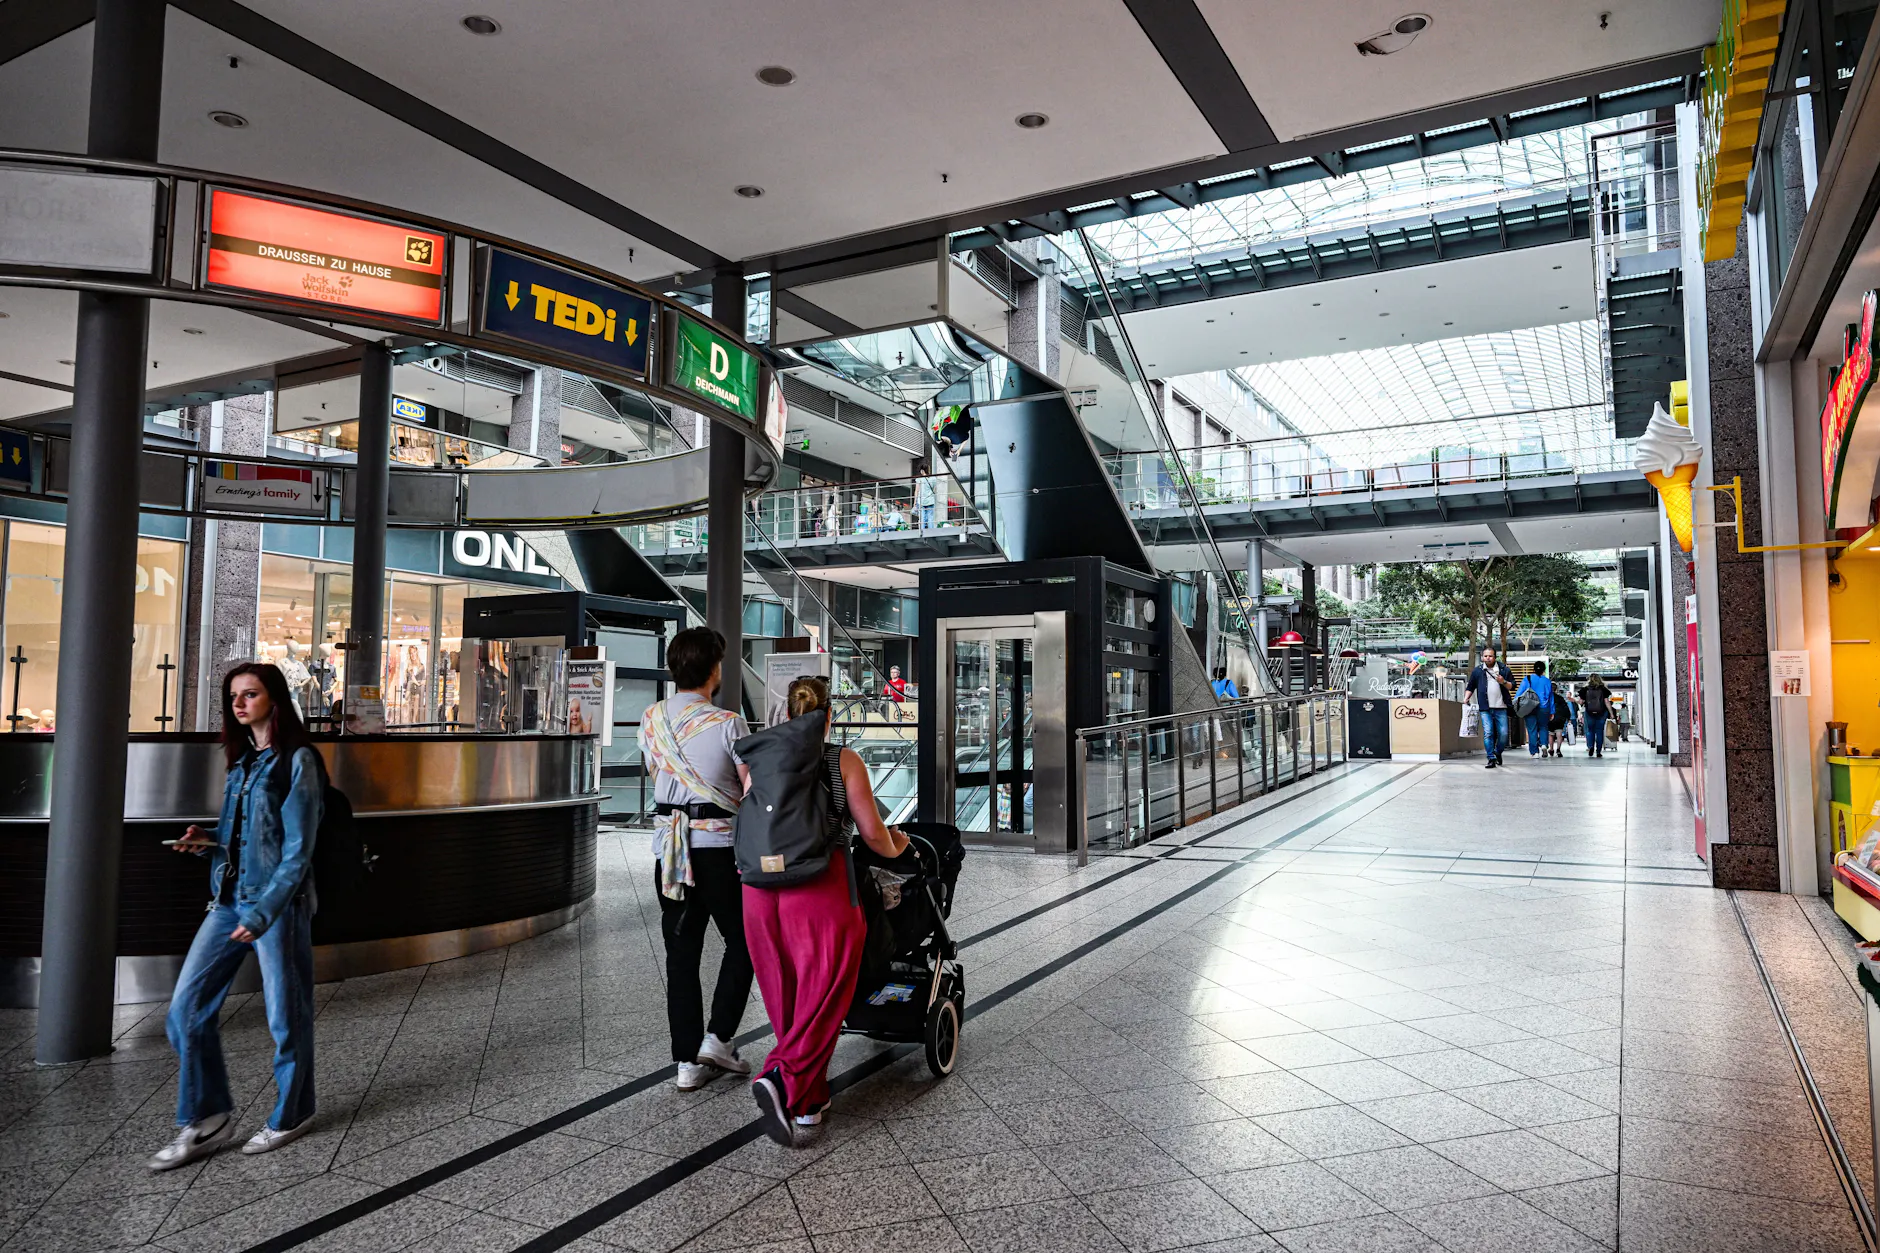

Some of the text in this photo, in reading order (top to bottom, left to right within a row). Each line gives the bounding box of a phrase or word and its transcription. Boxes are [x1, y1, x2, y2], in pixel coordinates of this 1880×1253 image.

[258, 245, 392, 279] DRAUSSEN ZU HAUSE
[302, 273, 329, 285] Jack
[302, 281, 349, 297] Wolfskin
[530, 283, 616, 342] TEDi
[710, 342, 729, 380] D
[695, 376, 740, 406] DEICHMANN
[215, 485, 301, 501] Ernsting's family
[453, 531, 561, 577] ONL
